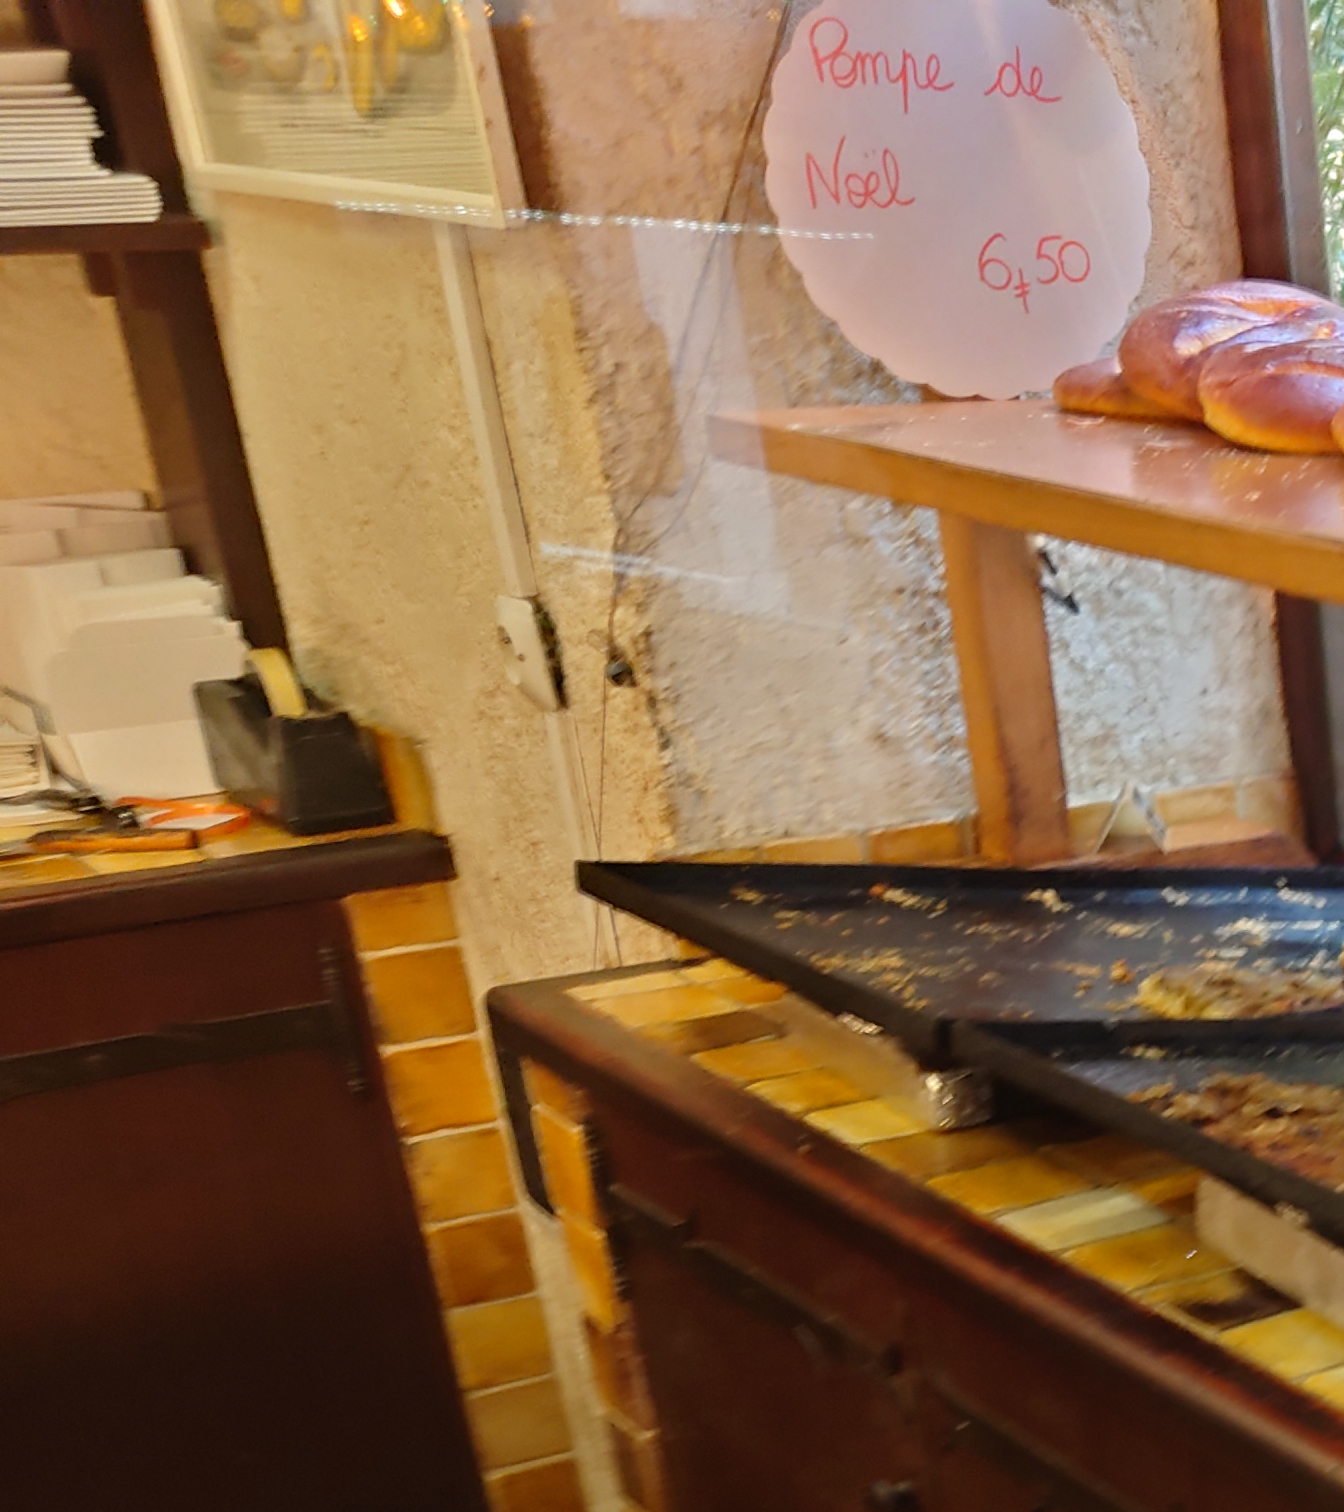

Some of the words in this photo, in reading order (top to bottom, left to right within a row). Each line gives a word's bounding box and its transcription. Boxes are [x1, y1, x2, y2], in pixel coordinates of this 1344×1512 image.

[809, 17, 954, 114] Pompe
[984, 46, 1062, 102] de
[806, 136, 915, 209] Noël
